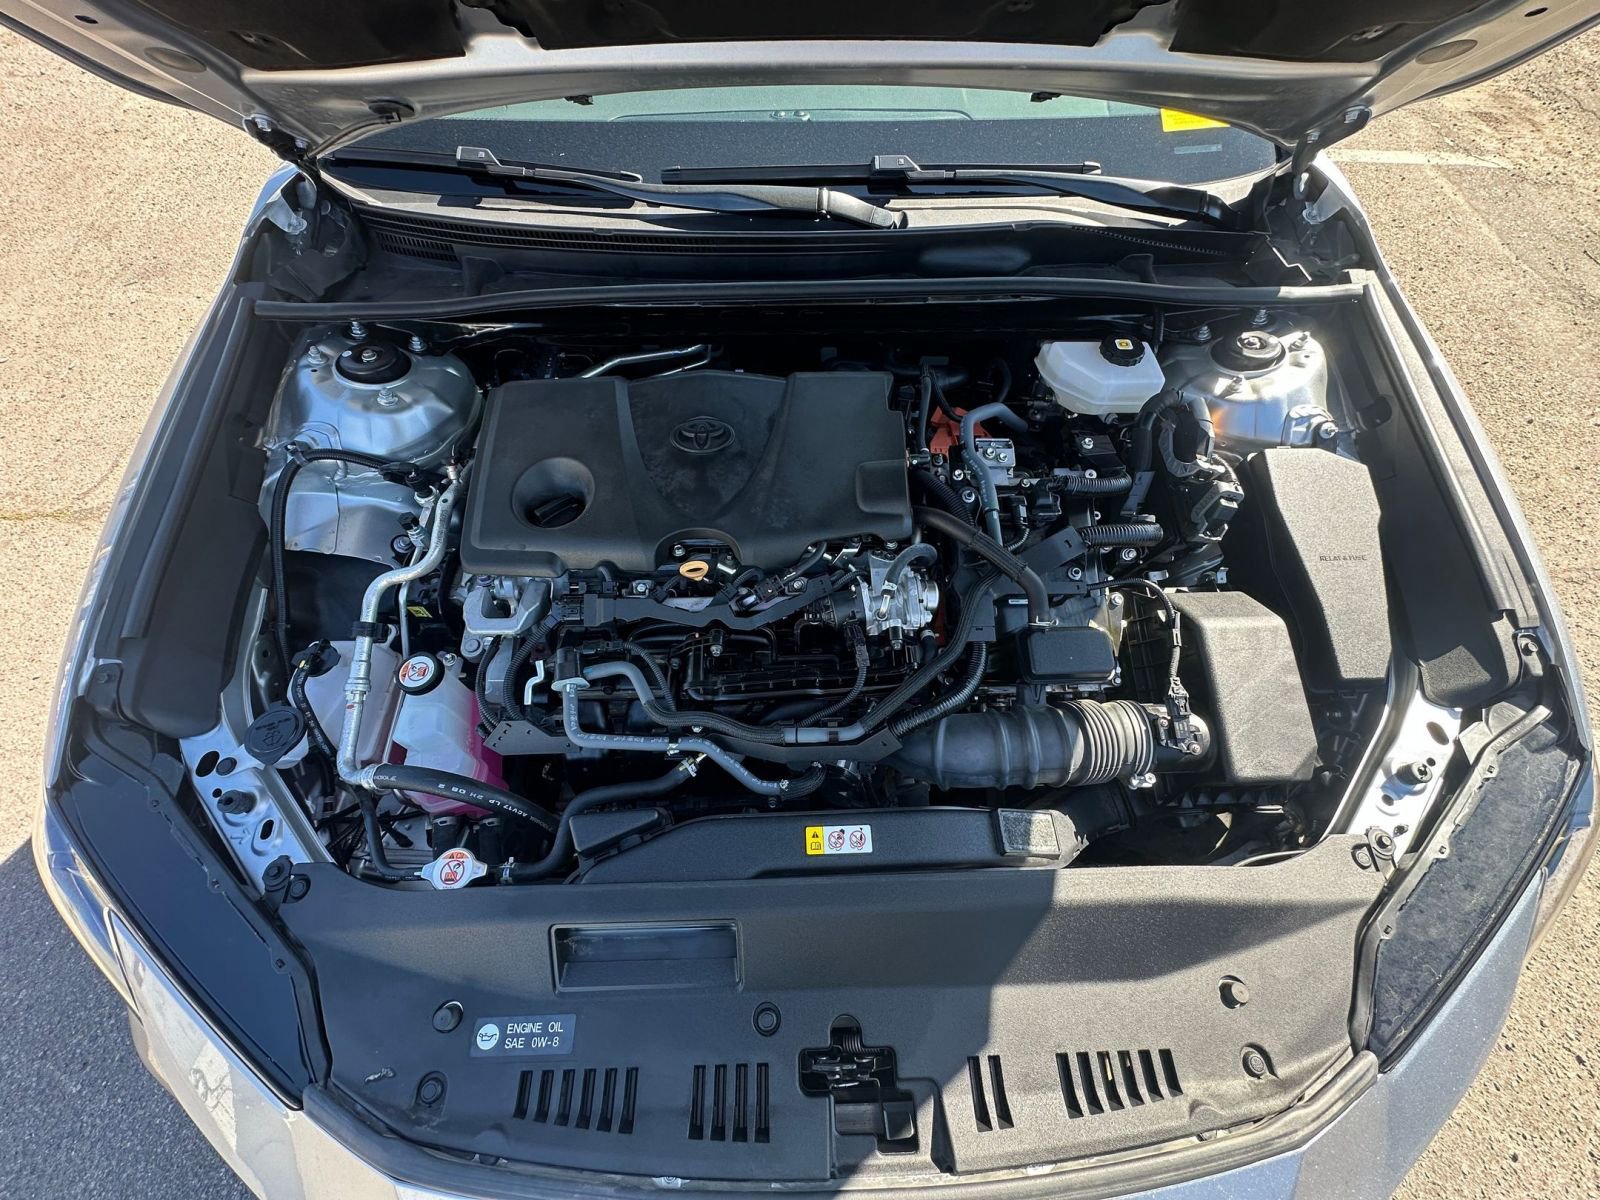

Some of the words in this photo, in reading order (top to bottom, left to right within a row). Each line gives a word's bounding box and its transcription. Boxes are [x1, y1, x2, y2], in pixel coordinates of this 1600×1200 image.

[506, 1022, 543, 1034] ENGINE
[548, 1021, 564, 1033] OIL
[504, 1037, 525, 1049] SAE
[531, 1036, 560, 1048] 0W-8
